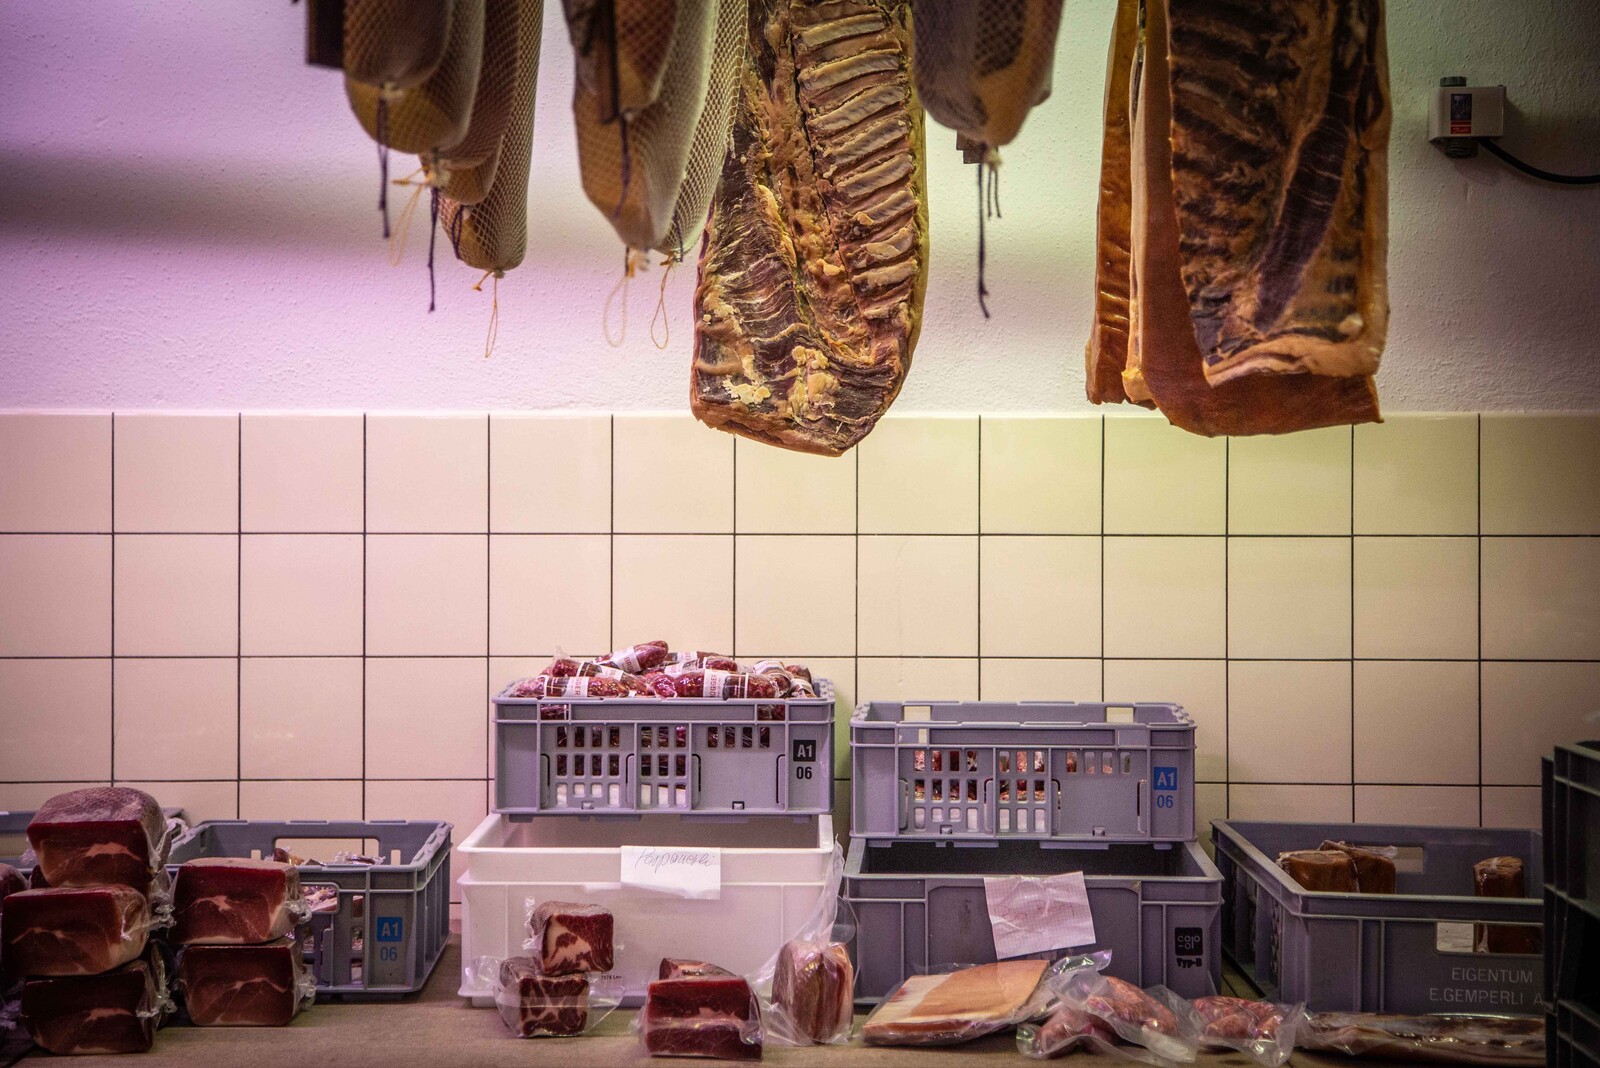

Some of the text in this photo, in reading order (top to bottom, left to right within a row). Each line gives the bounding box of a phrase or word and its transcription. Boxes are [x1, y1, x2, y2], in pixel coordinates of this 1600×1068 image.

[797, 744, 813, 758] A1
[796, 766, 812, 780] 06
[1157, 771, 1175, 787] A1
[1157, 794, 1173, 809] 06
[381, 922, 399, 937] A1
[380, 946, 397, 961] 06
[1451, 967, 1533, 984] EIGENTUM
